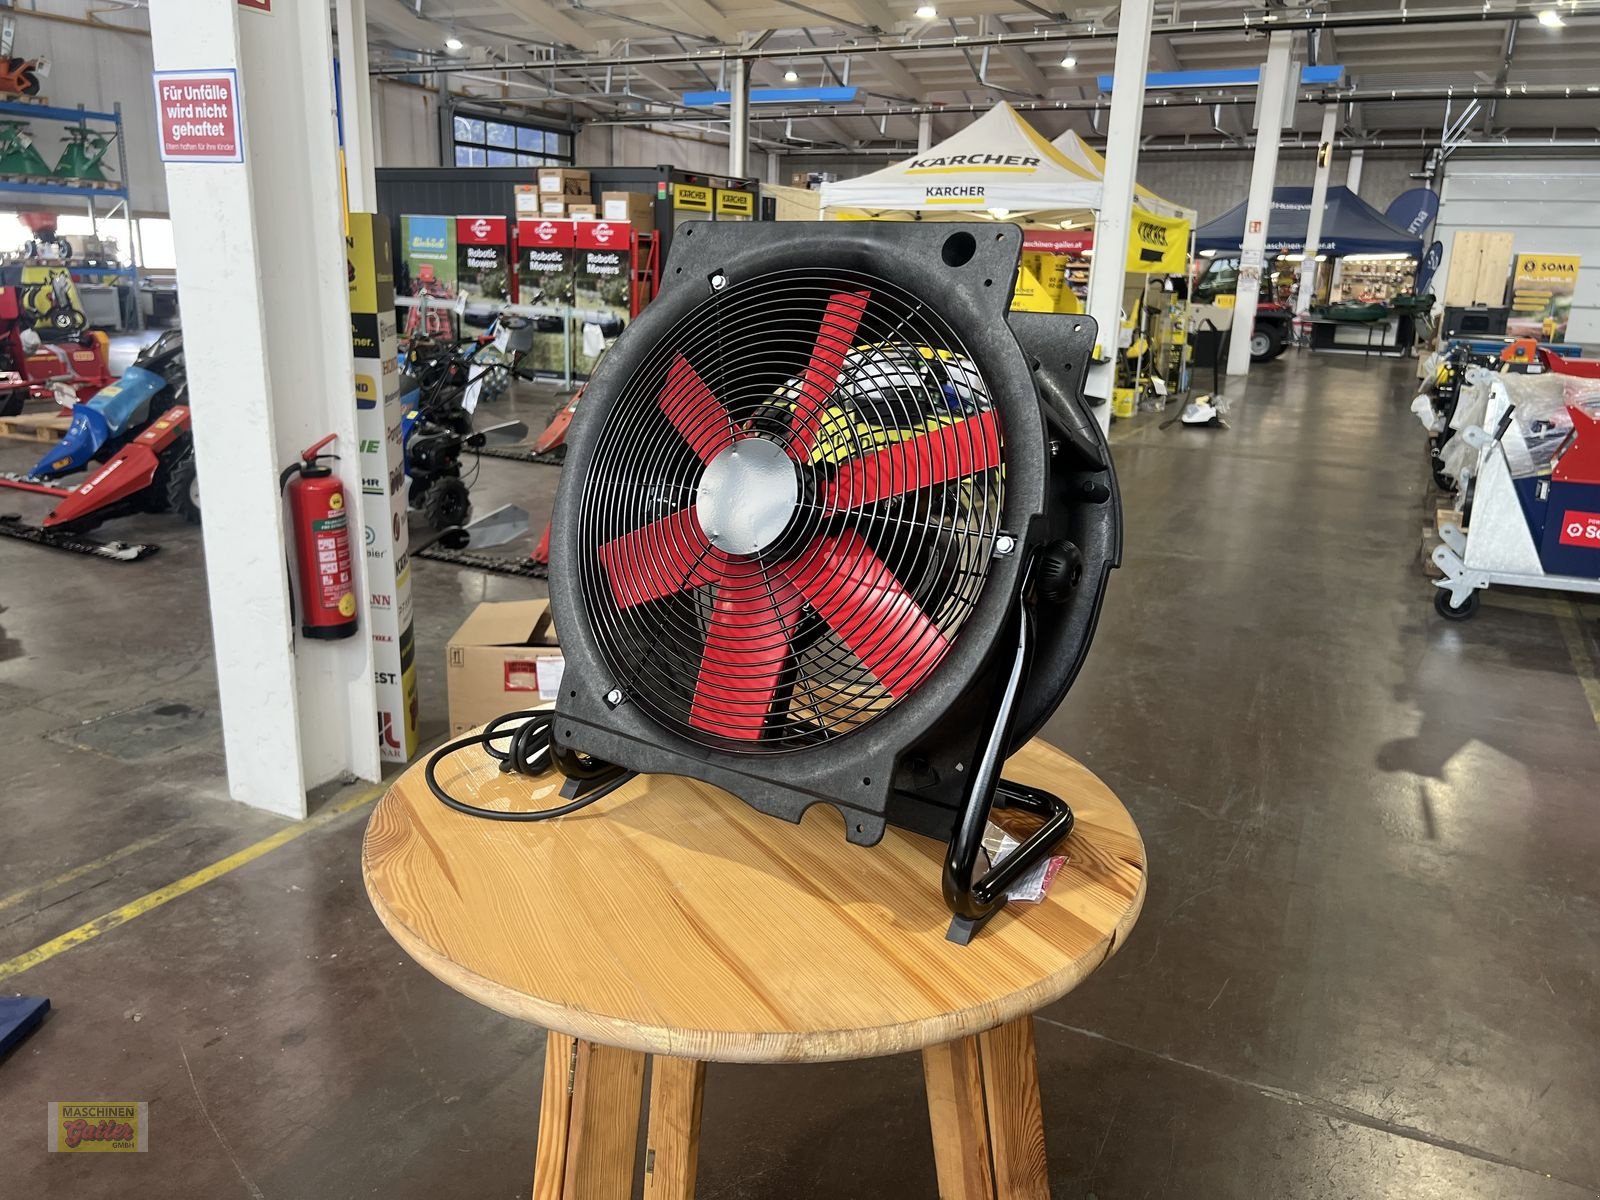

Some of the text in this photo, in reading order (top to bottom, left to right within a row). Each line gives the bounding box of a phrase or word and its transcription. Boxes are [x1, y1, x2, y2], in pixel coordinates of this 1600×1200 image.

[163, 84, 228, 101] Für Unfälle
[167, 102, 228, 118] wird nicht
[172, 121, 225, 141] gehaftet
[909, 154, 1041, 168] KÄRCHER
[926, 186, 985, 196] KÄRCHER
[467, 248, 496, 258] Robotic
[529, 251, 562, 261] Robotic
[587, 253, 619, 264] Robotic
[529, 261, 563, 271] Mowers
[586, 264, 619, 274] Mowers
[1541, 263, 1574, 272] SOMA
